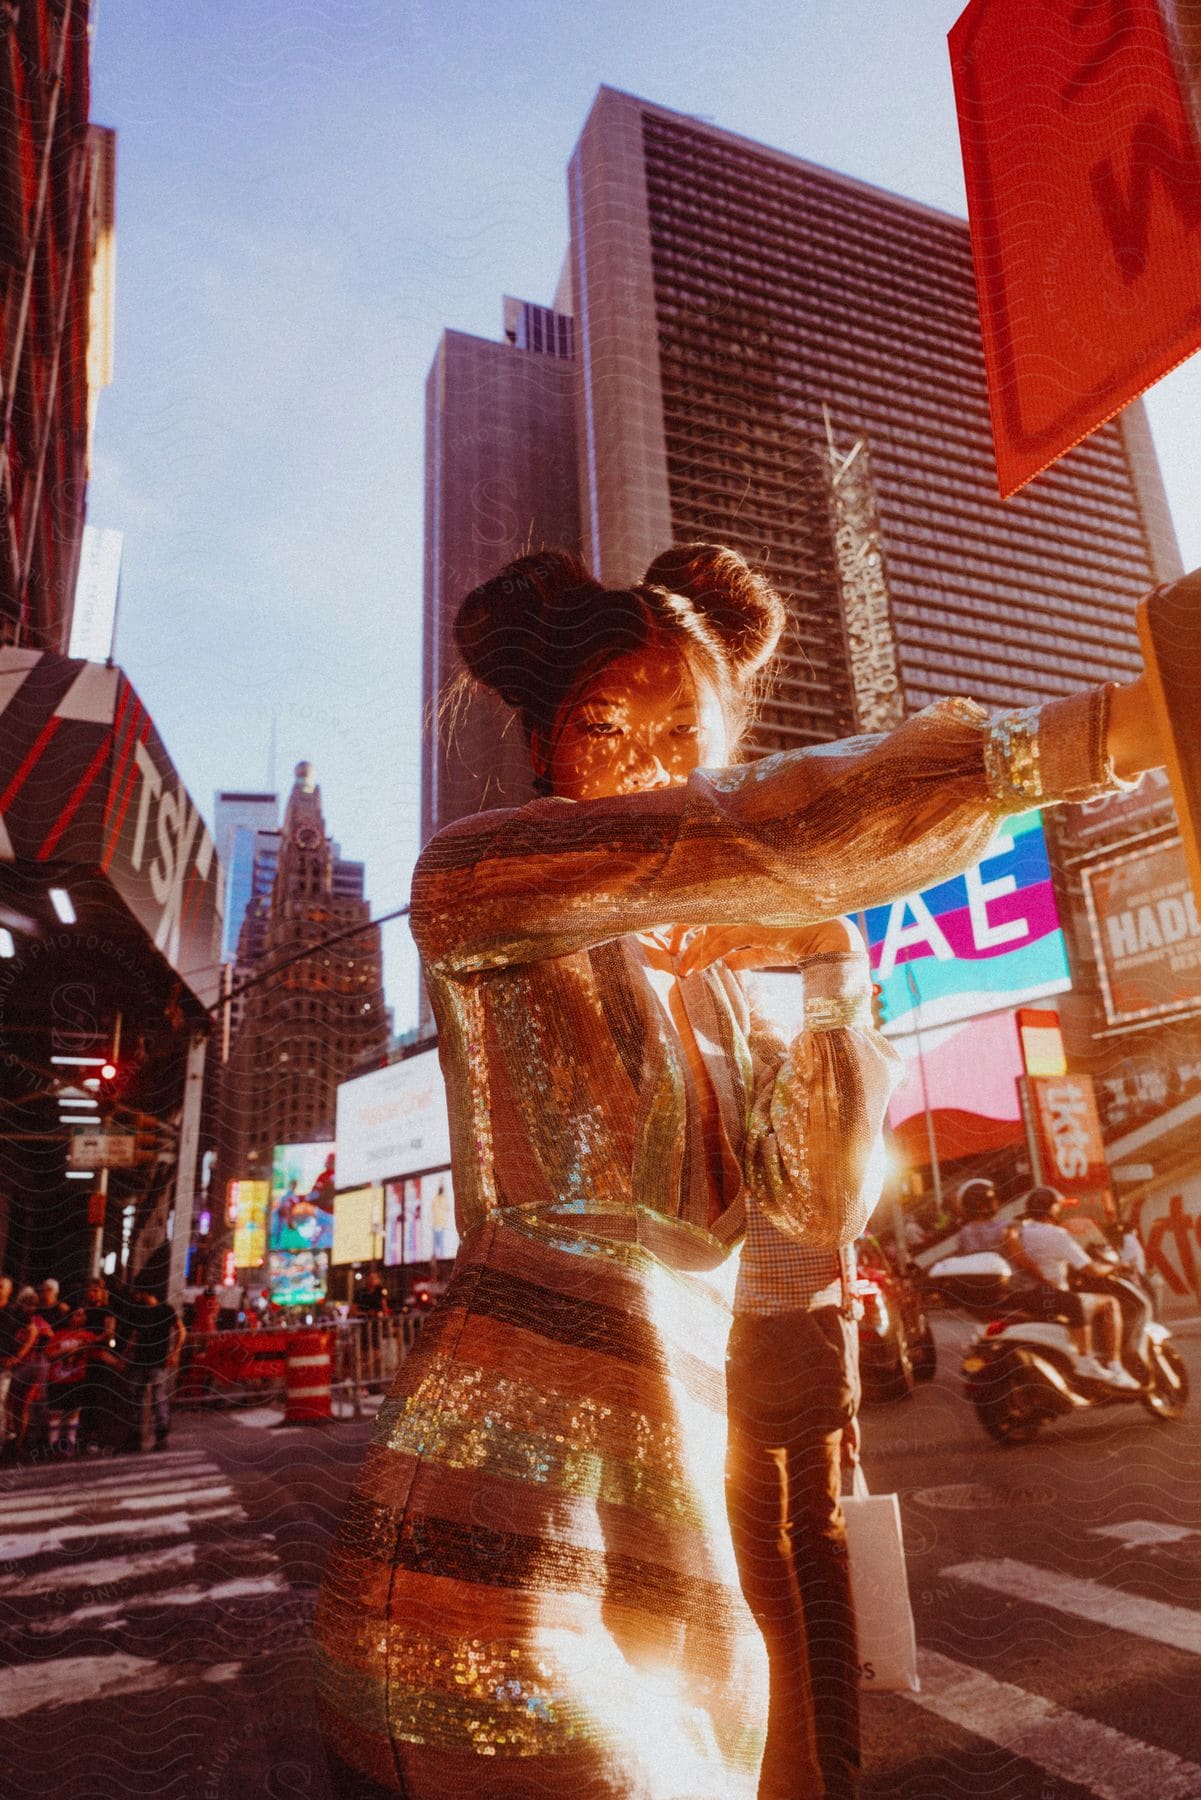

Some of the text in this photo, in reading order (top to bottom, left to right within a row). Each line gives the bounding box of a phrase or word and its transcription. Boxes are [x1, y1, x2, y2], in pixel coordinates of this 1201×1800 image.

[845, 602, 880, 729] AMERICAN
[864, 551, 898, 694] OUTFITTERS
[876, 833, 1030, 981] AE
[1046, 1083, 1090, 1179] tkts
